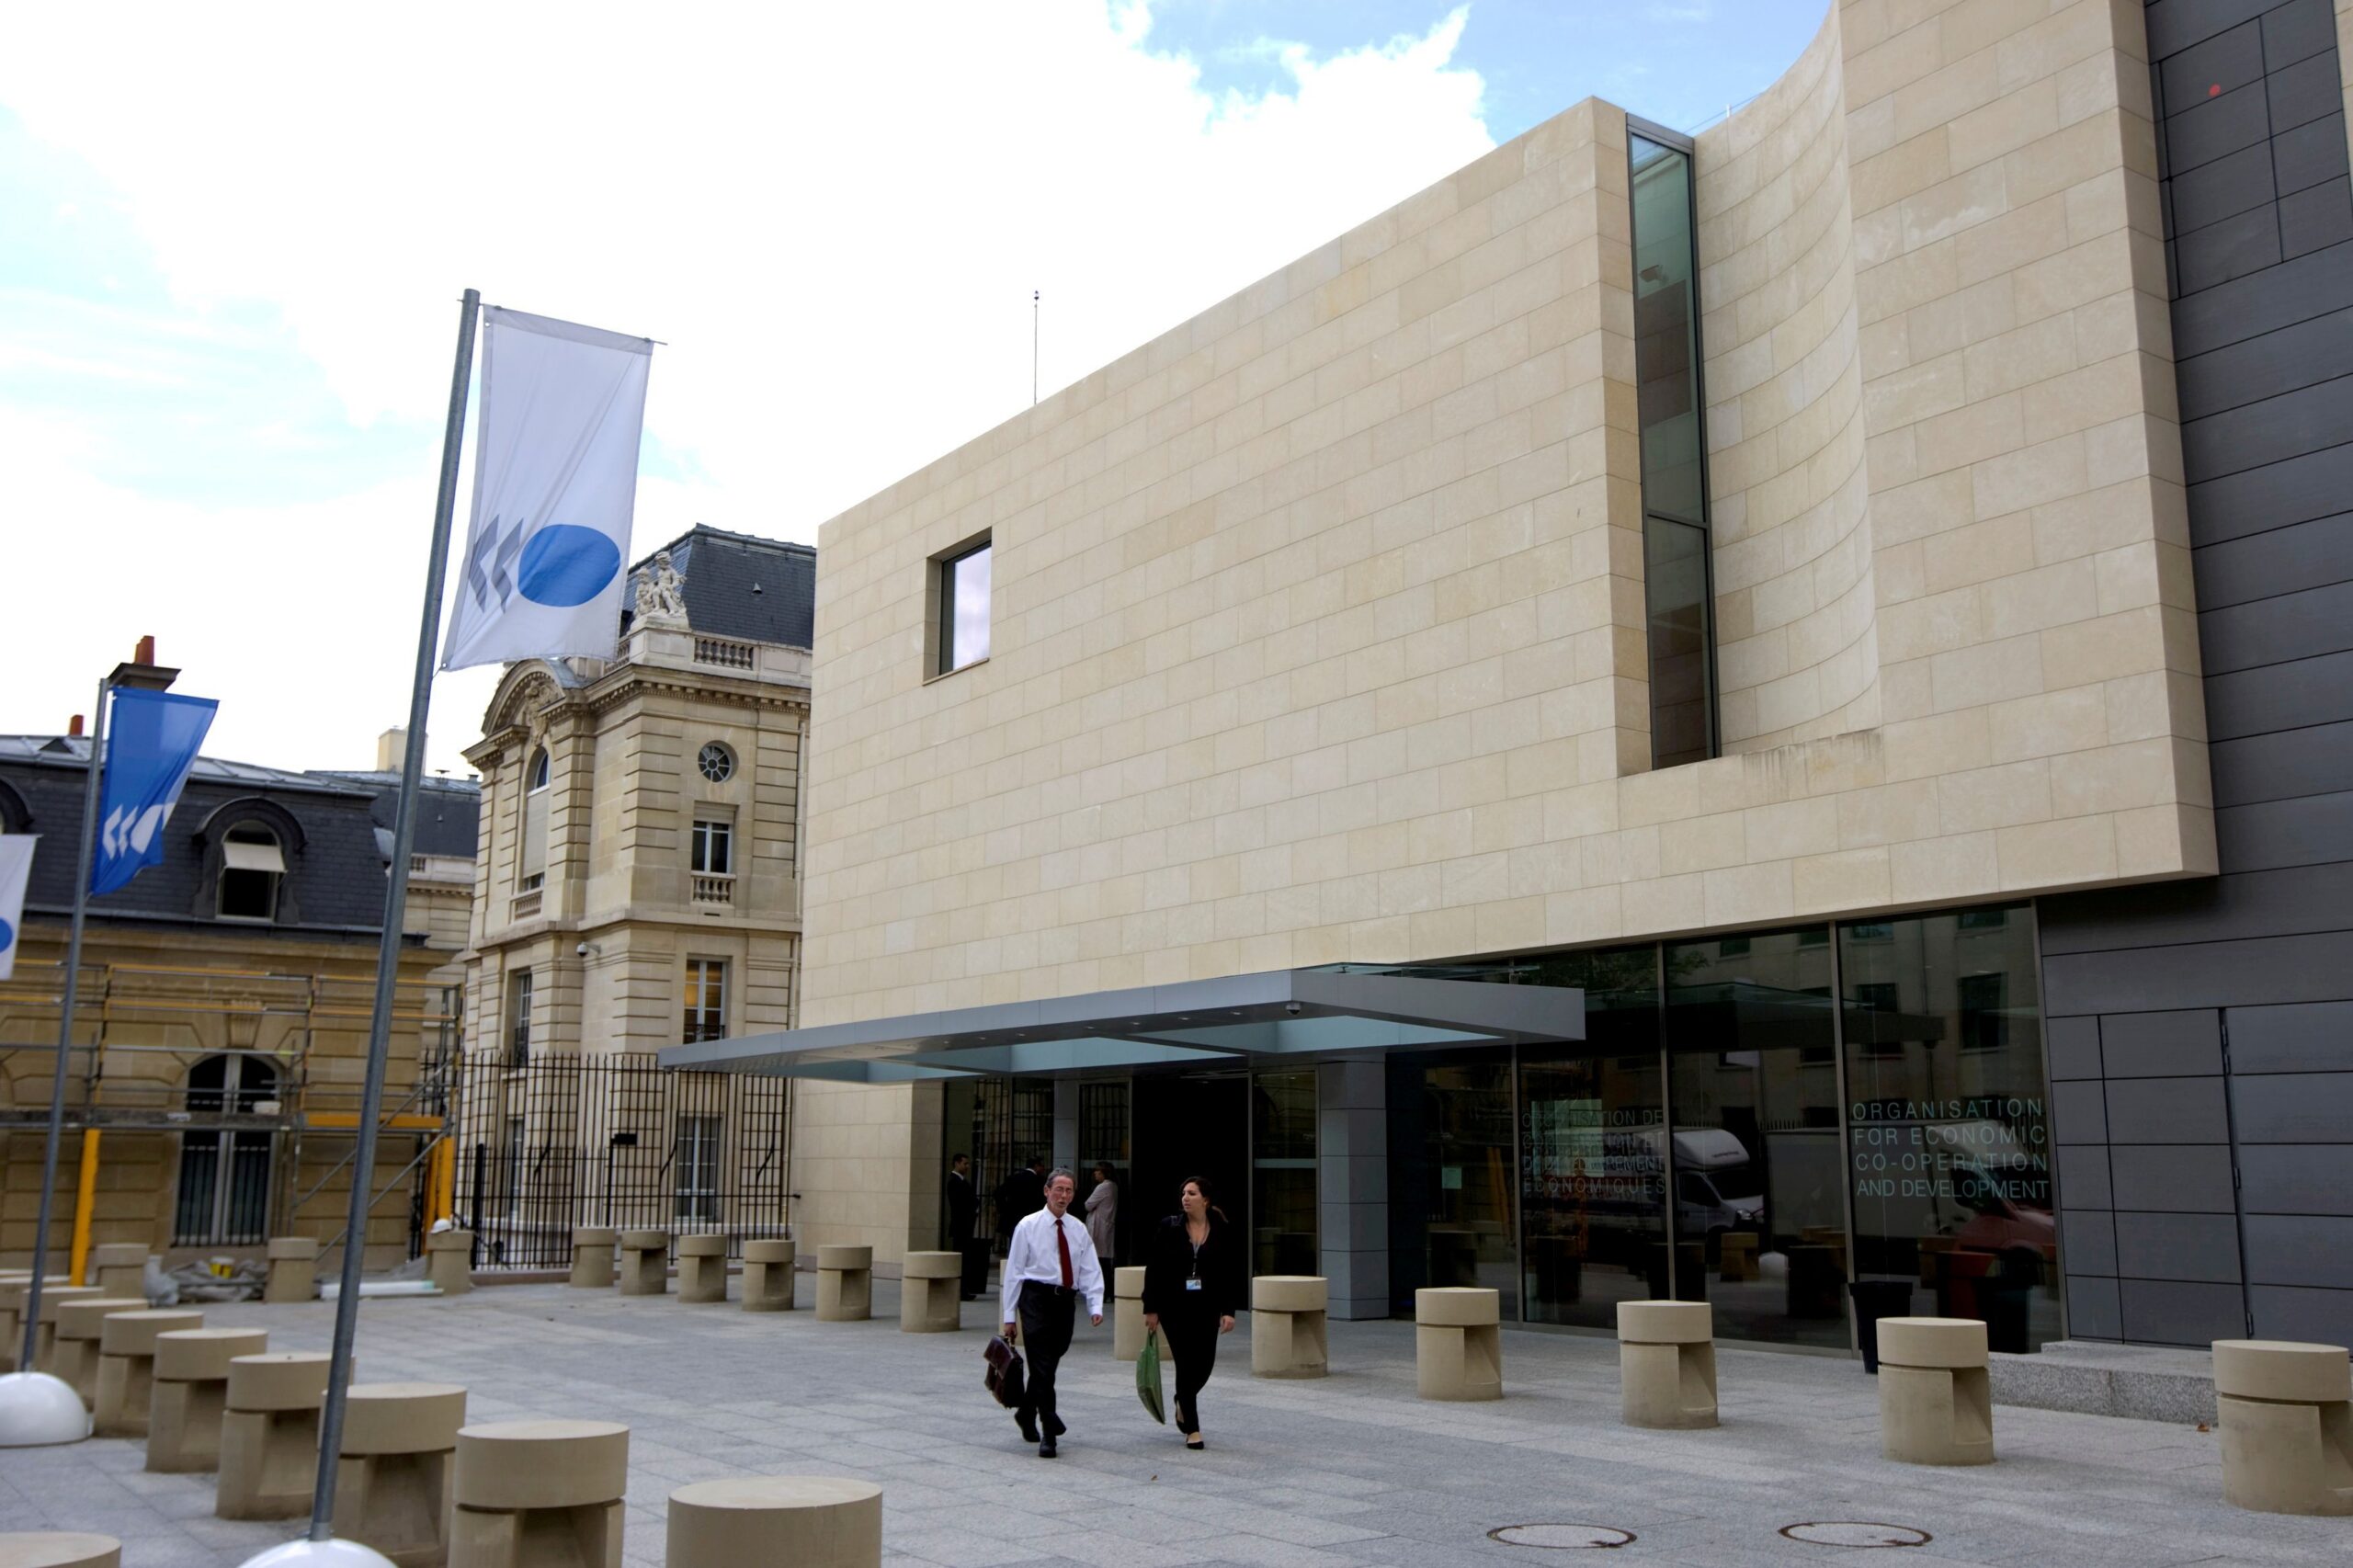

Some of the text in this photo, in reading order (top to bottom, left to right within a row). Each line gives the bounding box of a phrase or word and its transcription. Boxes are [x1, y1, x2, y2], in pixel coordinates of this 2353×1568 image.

[1522, 1109, 1663, 1128] ORGISATION DE
[1852, 1098, 2042, 1119] ORGANISATION
[1854, 1125, 2046, 1146] FOR ECONOMIC
[1856, 1152, 2048, 1172] CO-OPERATION
[1857, 1178, 2050, 1199] AND DEVELOPMENT
